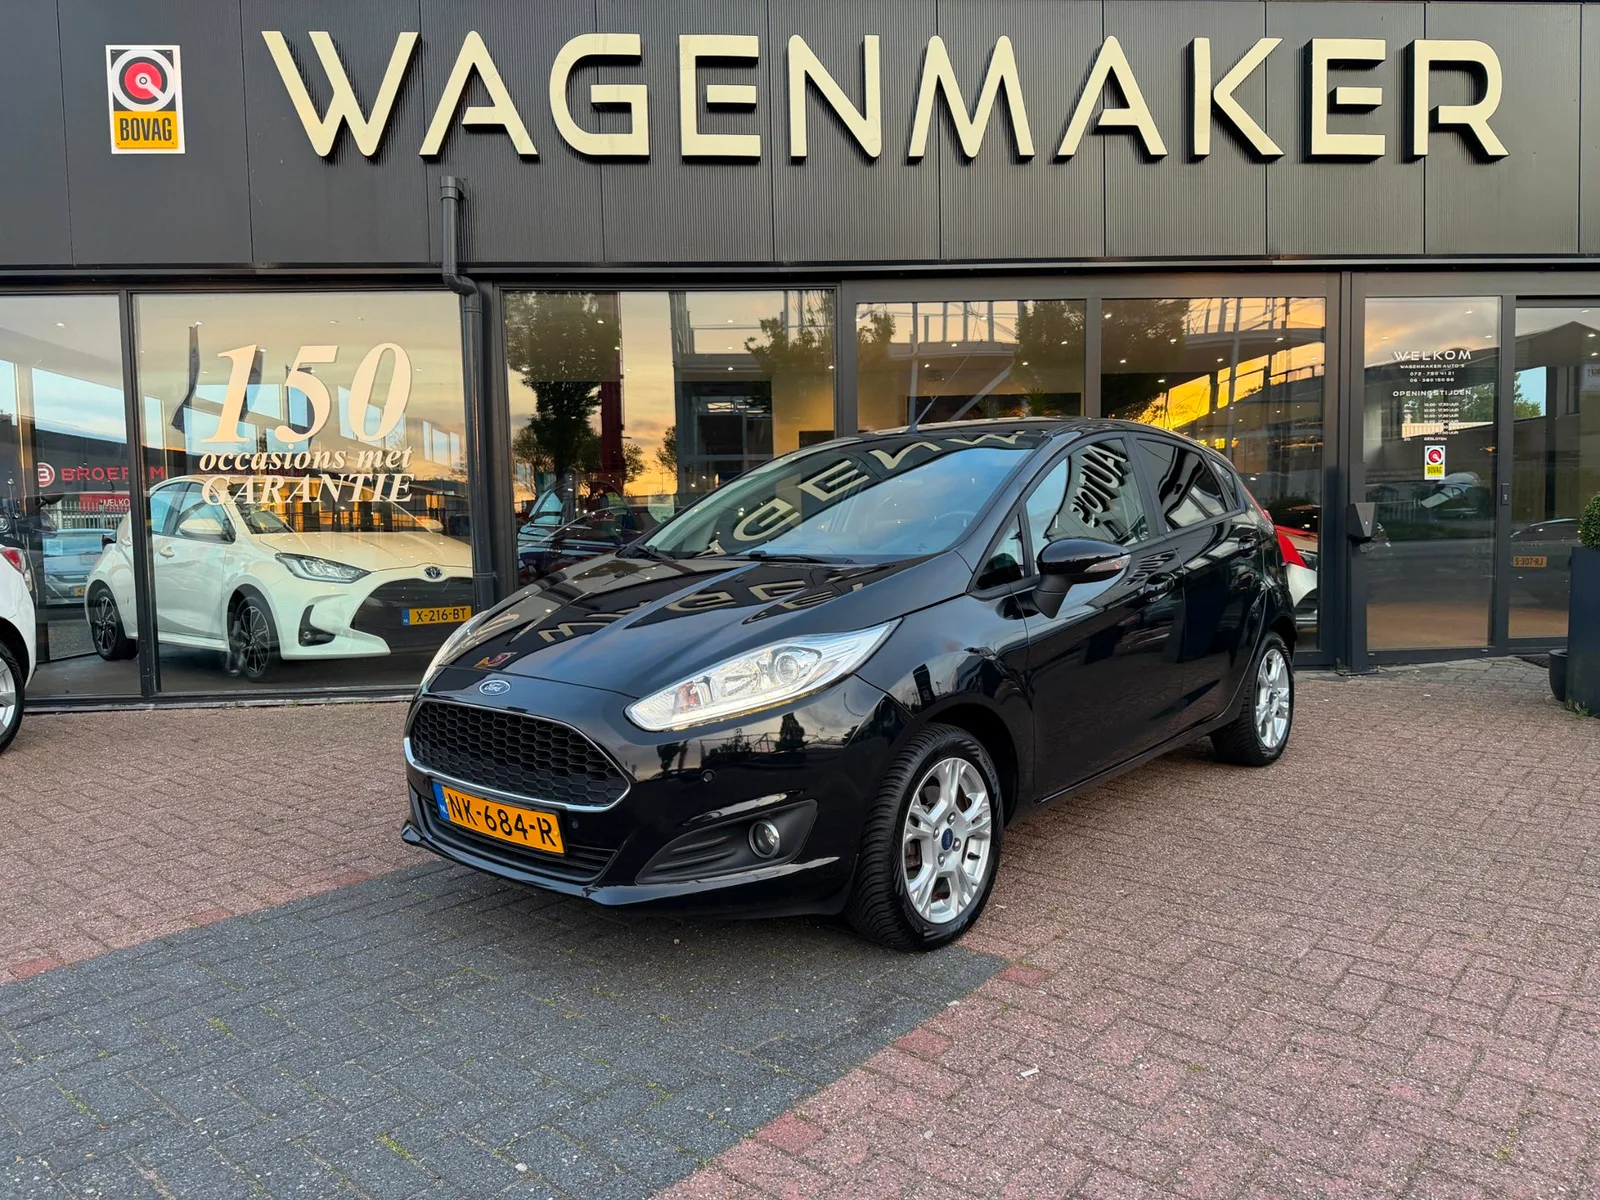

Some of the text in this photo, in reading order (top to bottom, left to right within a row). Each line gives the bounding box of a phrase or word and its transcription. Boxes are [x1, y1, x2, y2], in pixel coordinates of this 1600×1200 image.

[261, 30, 1511, 158] WAGENMAKER
[119, 117, 172, 141] BOVAG
[1393, 351, 1471, 360] WELKOM
[200, 342, 412, 444] 150
[1392, 389, 1472, 397] OPENINGSTIJDEN
[199, 443, 413, 471] occasions met
[201, 473, 415, 506] GARANTIE
[416, 608, 467, 623] X-216-BT
[447, 793, 557, 847] NK-684-R
